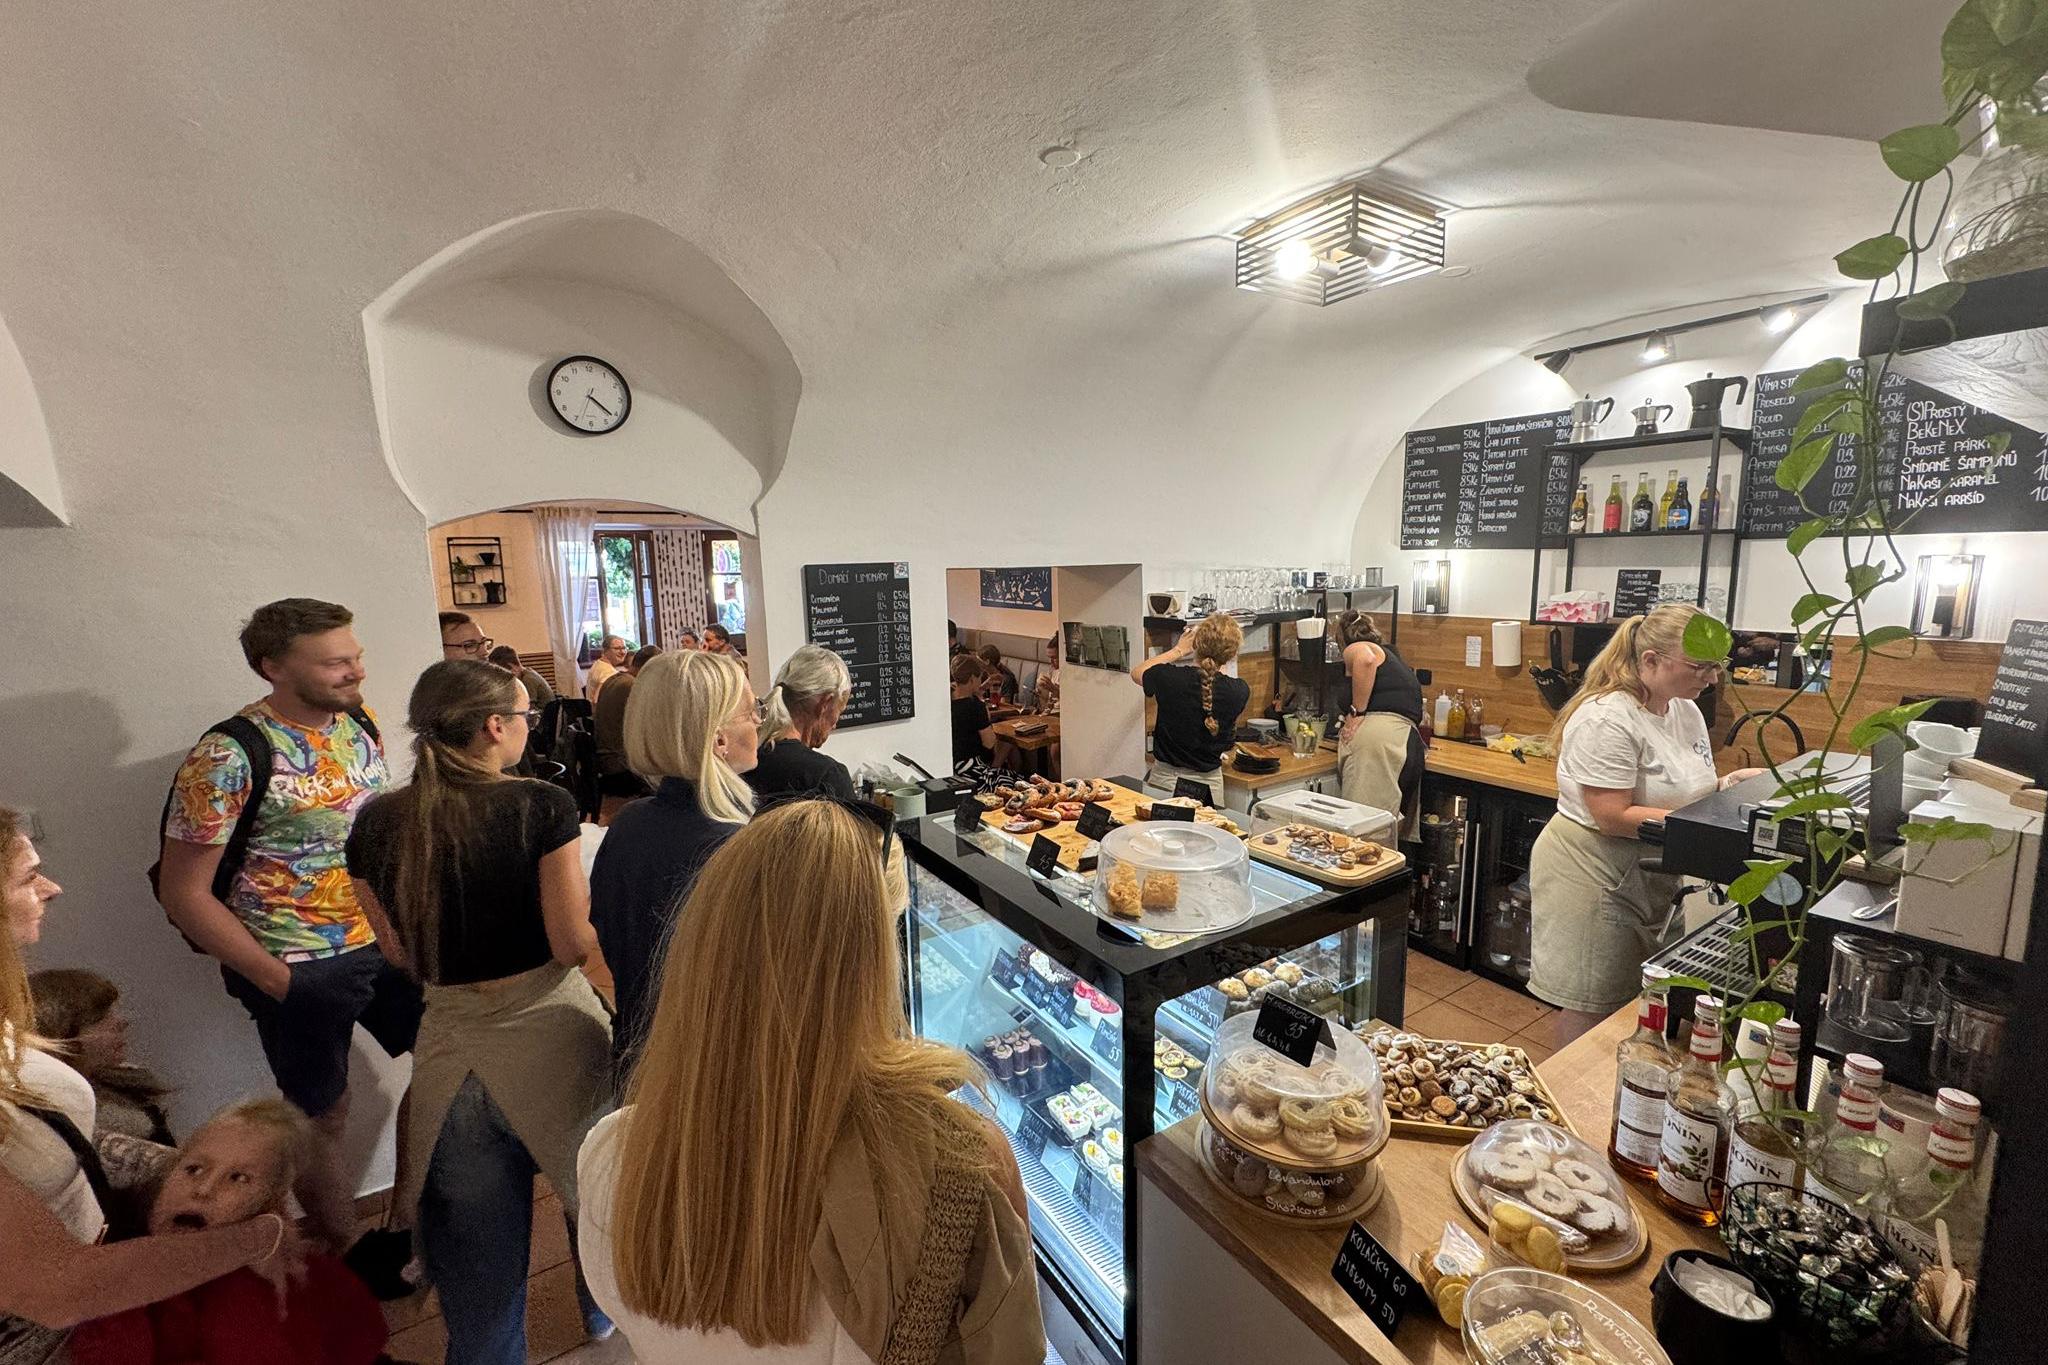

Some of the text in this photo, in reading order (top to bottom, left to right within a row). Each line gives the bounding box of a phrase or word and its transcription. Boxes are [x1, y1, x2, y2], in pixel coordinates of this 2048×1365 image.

[1751, 440, 1787, 455] MIMOSA
[1944, 490, 1985, 506] ARAŠÍD
[1992, 678, 2032, 697] SMOOTHIE
[1392, 1276, 1407, 1297] 60
[1381, 1302, 1395, 1325] 50
